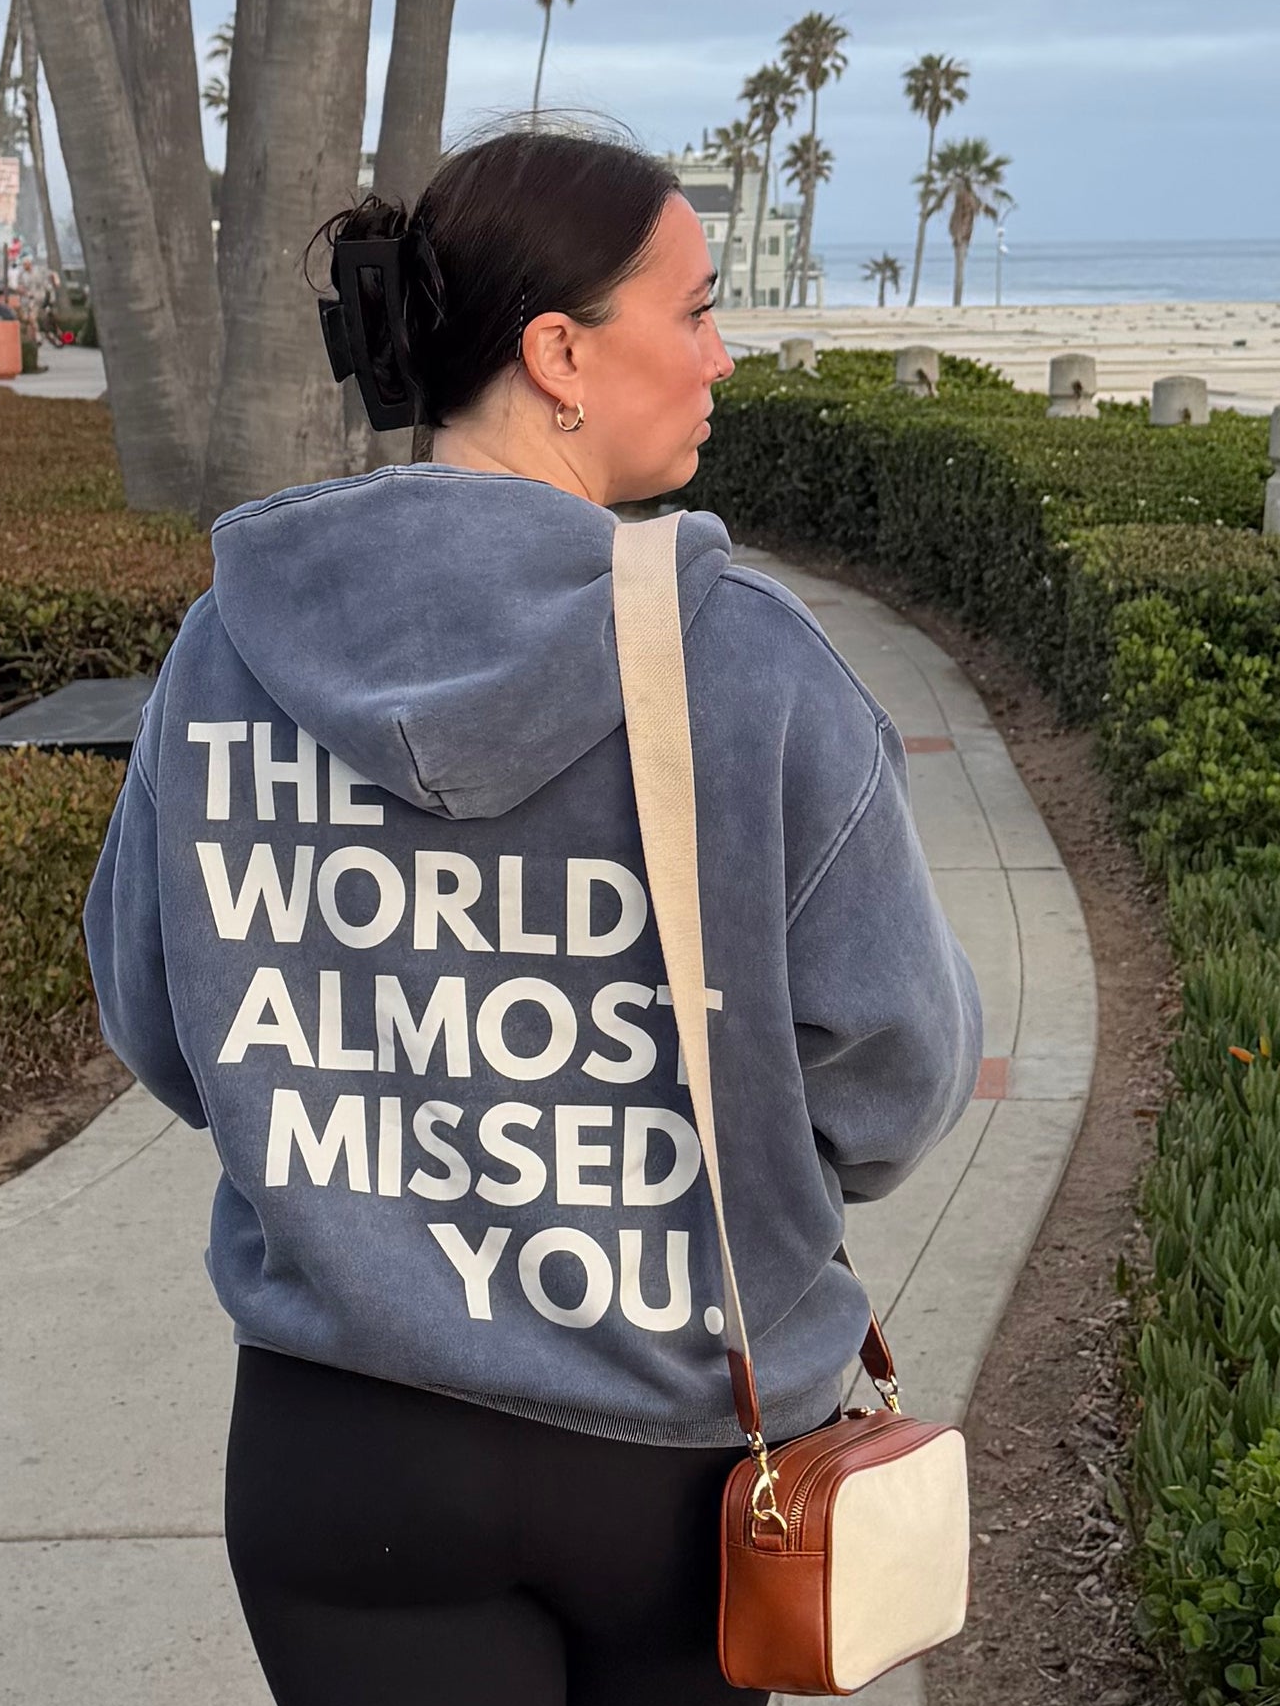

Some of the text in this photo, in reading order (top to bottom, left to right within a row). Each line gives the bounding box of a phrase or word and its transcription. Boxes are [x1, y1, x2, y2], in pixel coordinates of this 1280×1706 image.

[195, 841, 649, 958] WORLD
[264, 1087, 702, 1207] MISSED
[426, 1222, 725, 1336] YOU.
